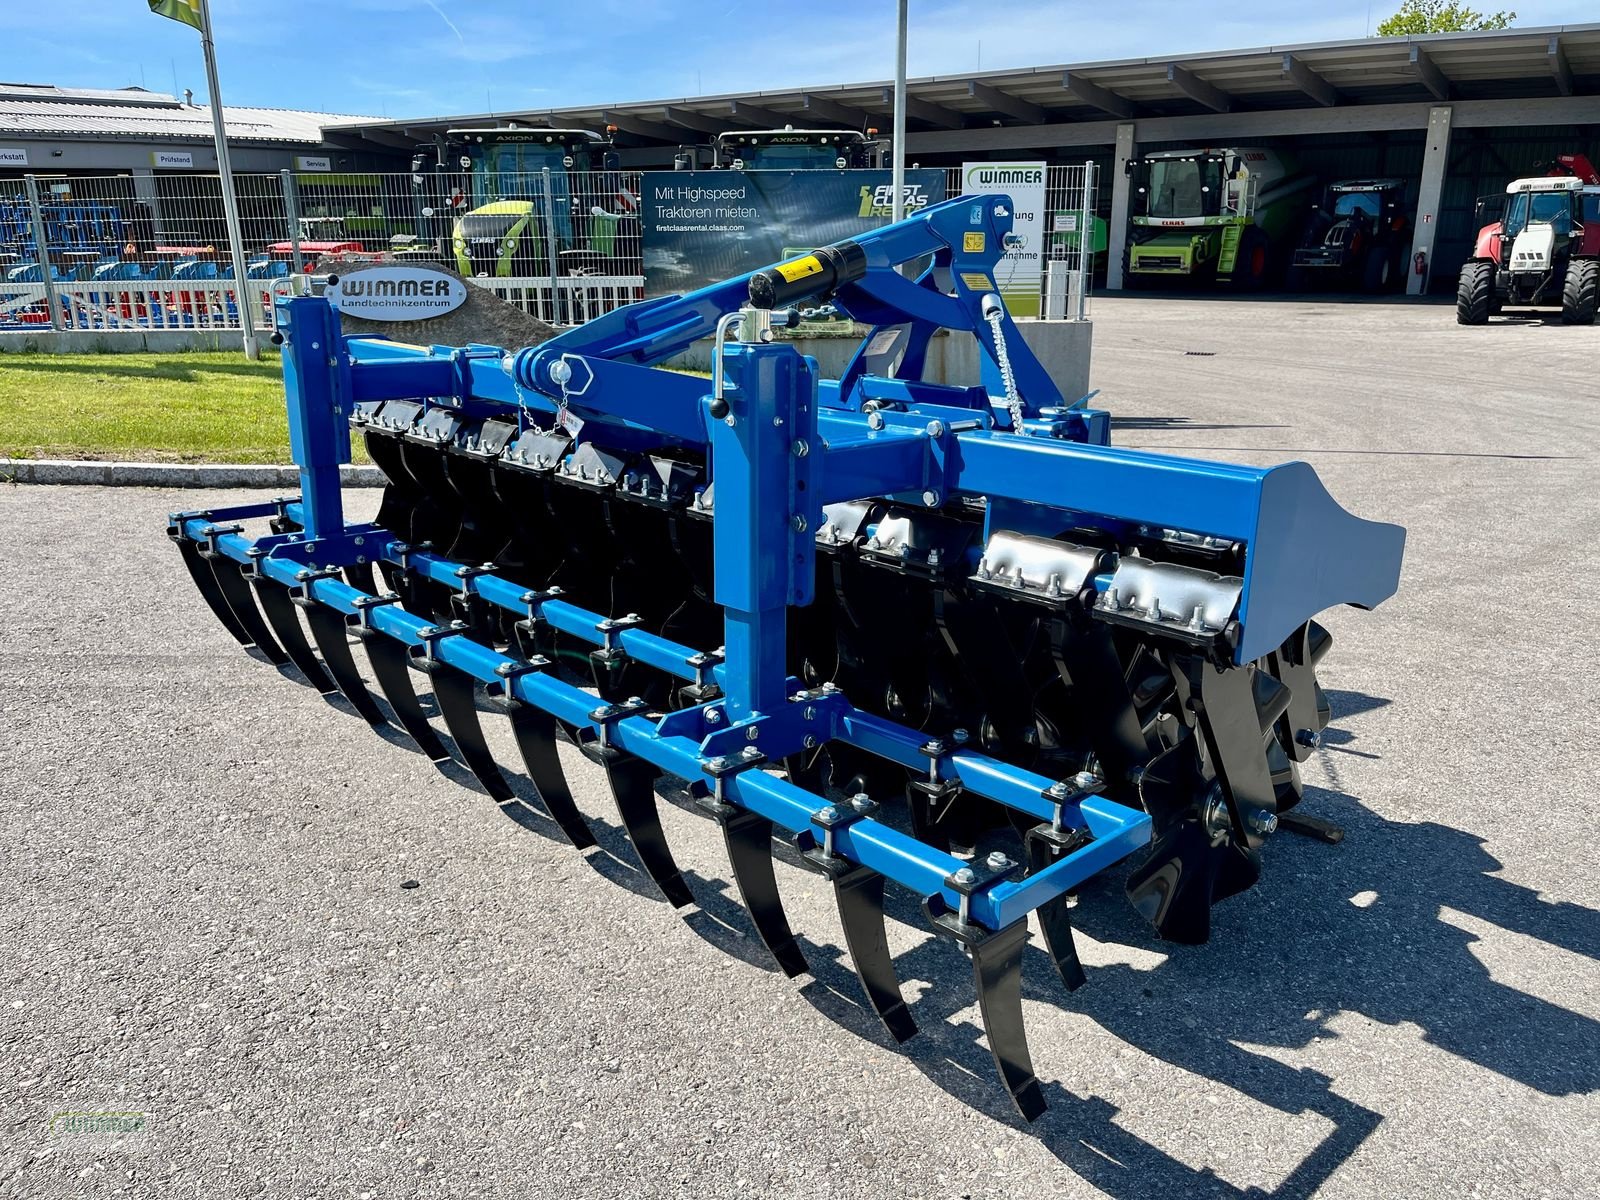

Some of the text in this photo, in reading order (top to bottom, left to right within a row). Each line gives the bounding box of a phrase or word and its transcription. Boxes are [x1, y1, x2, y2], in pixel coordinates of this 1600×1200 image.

[160, 155, 191, 163] Prüfstand
[980, 170, 1042, 184] WIMMER
[655, 186, 746, 203] Mit Highspeed
[875, 185, 922, 196] FIST
[873, 195, 928, 206] CLAS
[655, 205, 760, 219] Traktoren mieten.
[655, 224, 745, 232] firstclaasrental.claas.com
[341, 280, 450, 297] WIMMER
[341, 299, 451, 308] Landtechnikzentrum
